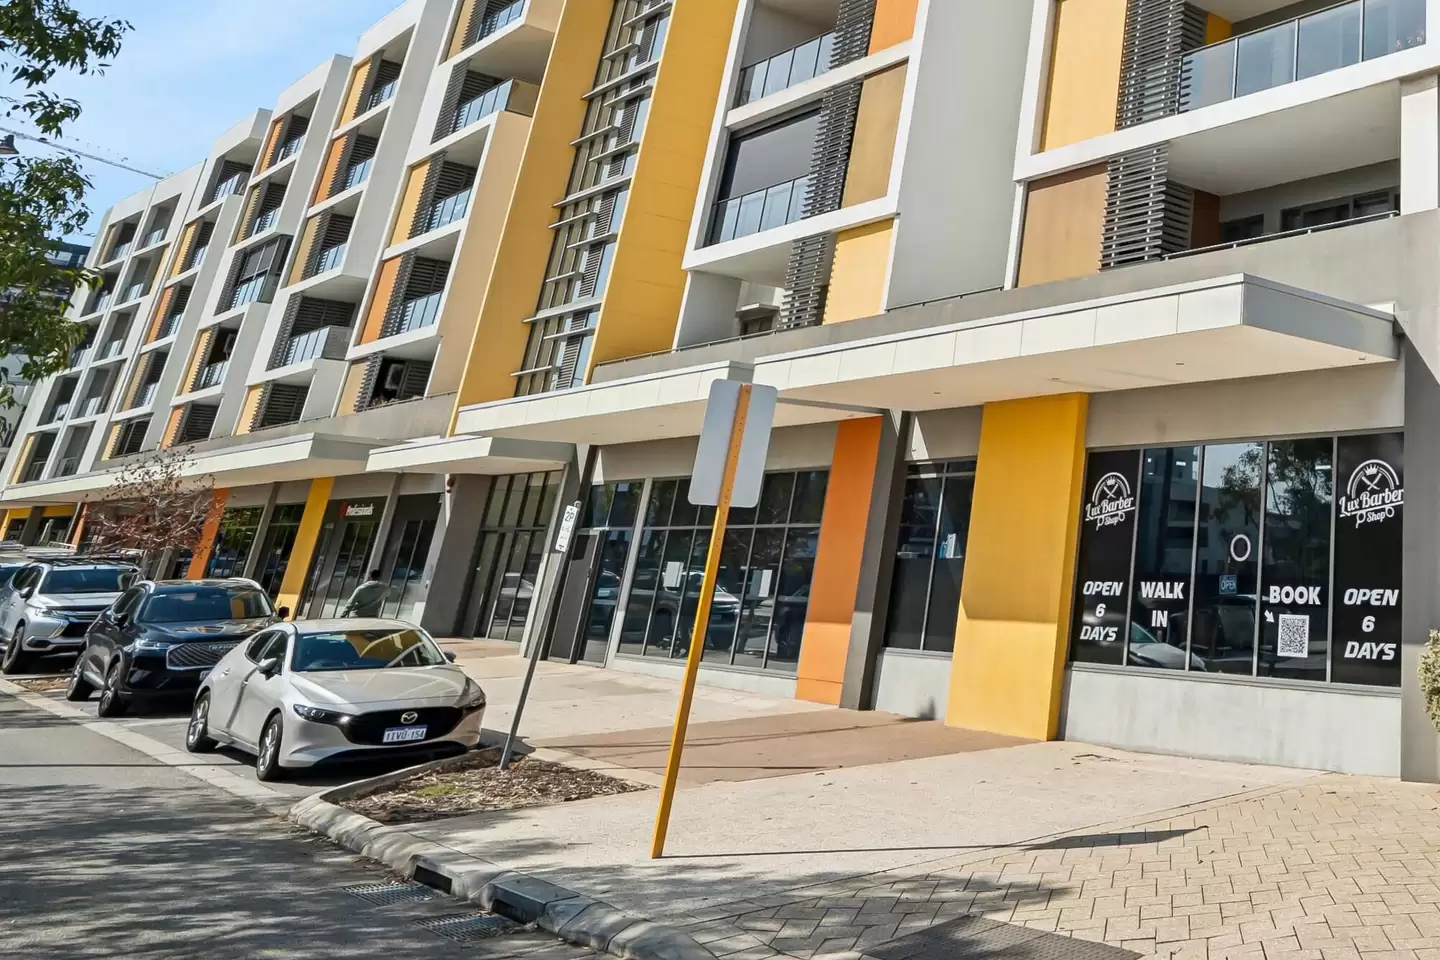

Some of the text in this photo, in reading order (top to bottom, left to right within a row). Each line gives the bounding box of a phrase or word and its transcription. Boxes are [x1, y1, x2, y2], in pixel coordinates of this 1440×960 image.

[1085, 496, 1134, 520] Lux Barber
[1339, 488, 1404, 516] Lux Barber
[1366, 511, 1386, 523] Shop
[1083, 581, 1123, 596] OPEN
[1140, 581, 1184, 600] WALK
[1269, 585, 1321, 606] BOOK
[1344, 589, 1399, 607] OPEN
[1095, 603, 1106, 618] 6
[1151, 610, 1168, 628] IN
[1362, 615, 1375, 633] 6
[1080, 627, 1118, 642] DAYS
[1344, 641, 1397, 661] DAYS
